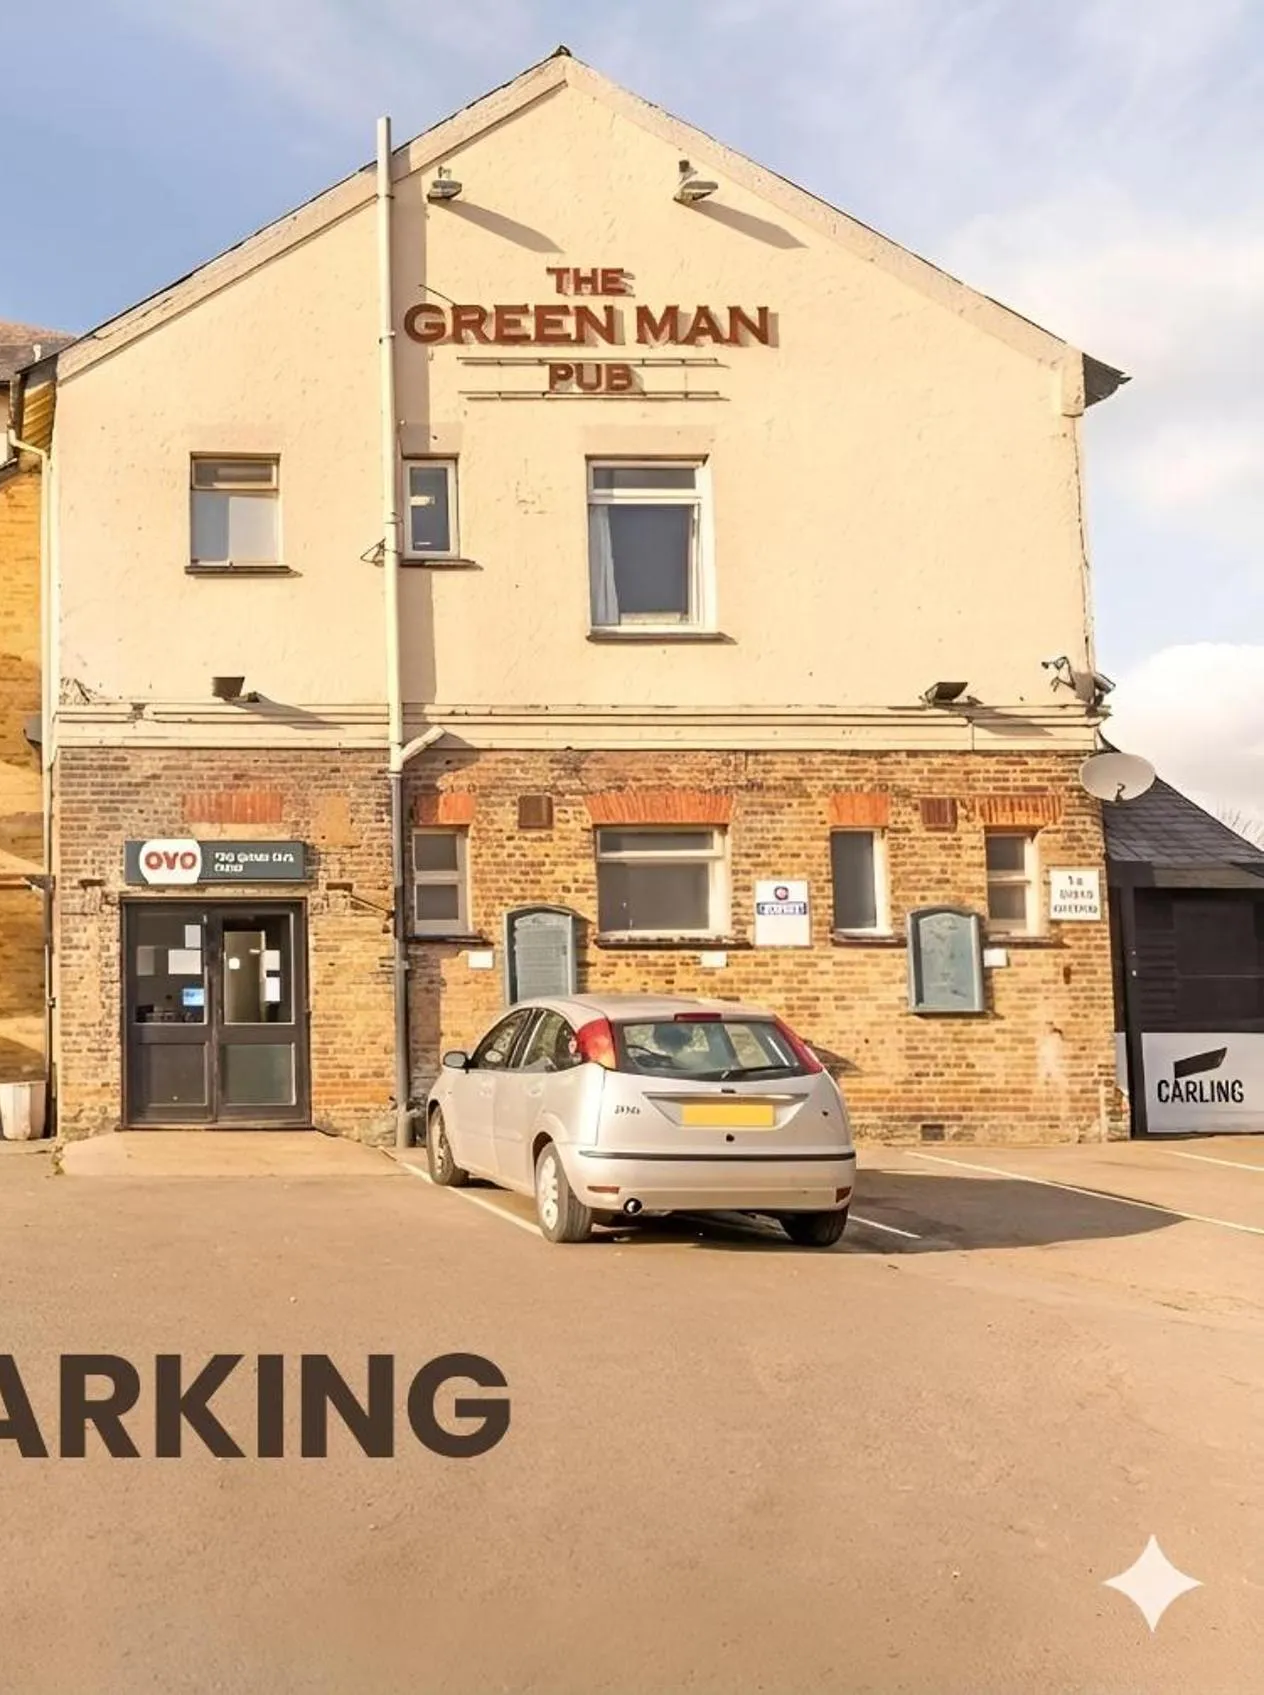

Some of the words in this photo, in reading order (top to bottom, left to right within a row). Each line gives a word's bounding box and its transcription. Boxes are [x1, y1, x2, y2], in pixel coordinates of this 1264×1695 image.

[546, 267, 626, 295] THE
[403, 303, 616, 345] GREEN
[635, 304, 770, 345] MAN
[548, 363, 634, 392] PUB
[144, 851, 198, 870] OVO
[1157, 1079, 1244, 1103] CARLING
